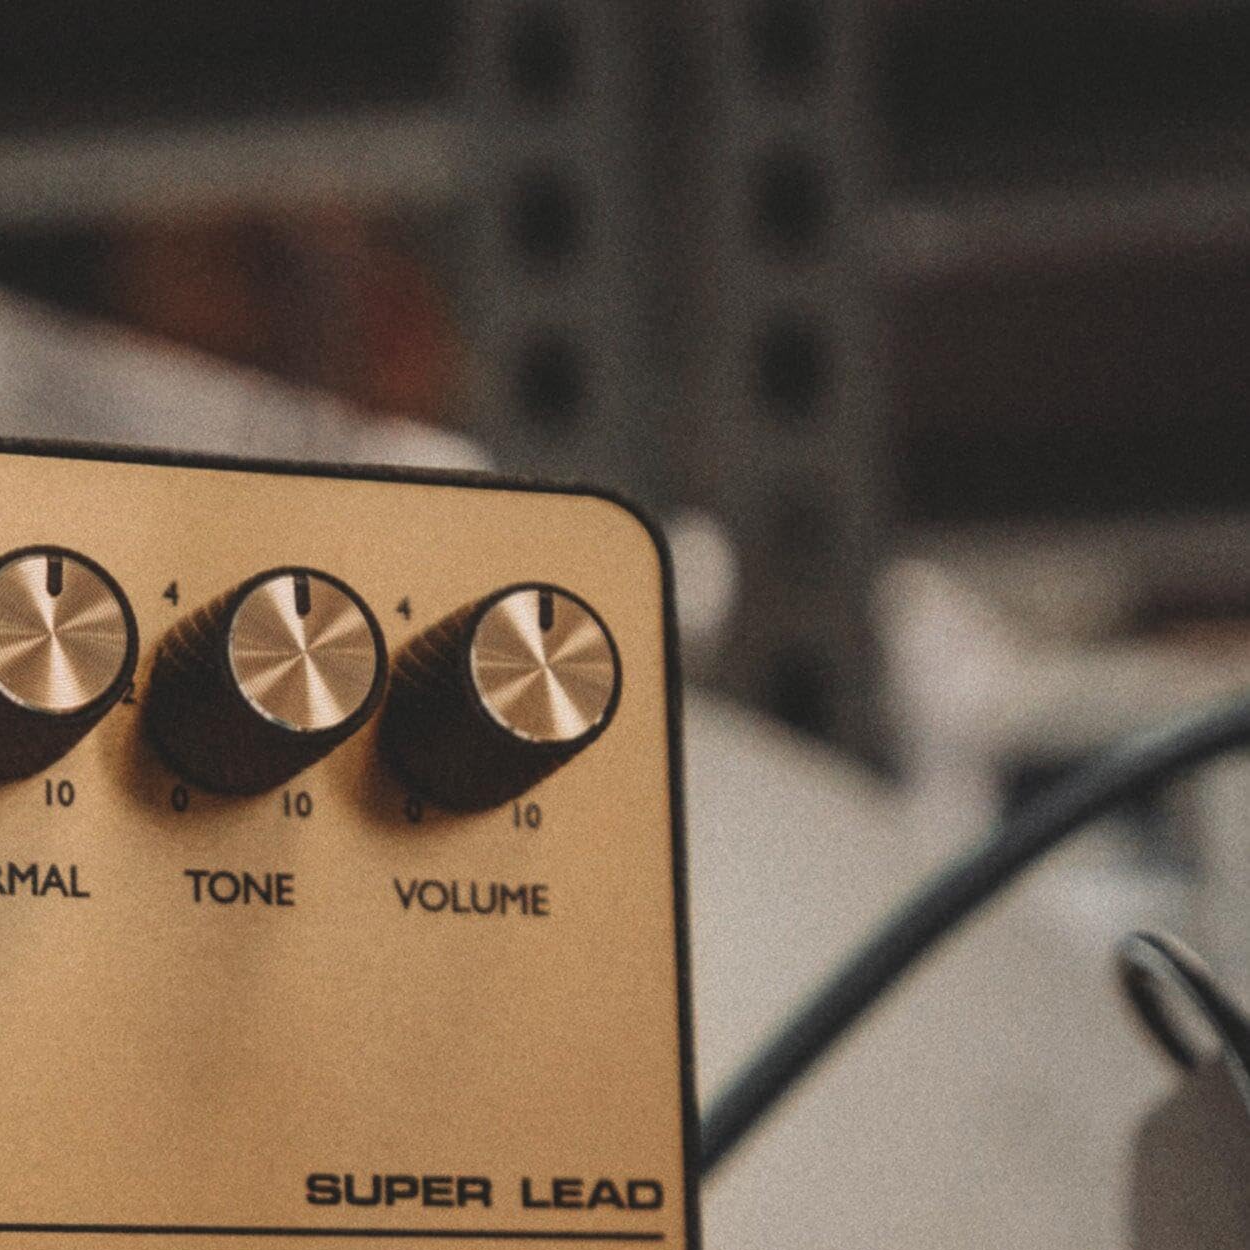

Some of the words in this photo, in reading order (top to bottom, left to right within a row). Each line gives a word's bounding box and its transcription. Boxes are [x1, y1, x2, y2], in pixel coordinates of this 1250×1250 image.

[162, 581, 179, 606] 4
[396, 597, 412, 621] 4
[44, 779, 75, 807] 10
[283, 791, 313, 818] 10
[513, 802, 541, 829] 10
[183, 869, 295, 907] TONE
[393, 877, 551, 917] VOLUME
[305, 1172, 493, 1208] SUPER
[521, 1176, 664, 1211] LEAD
